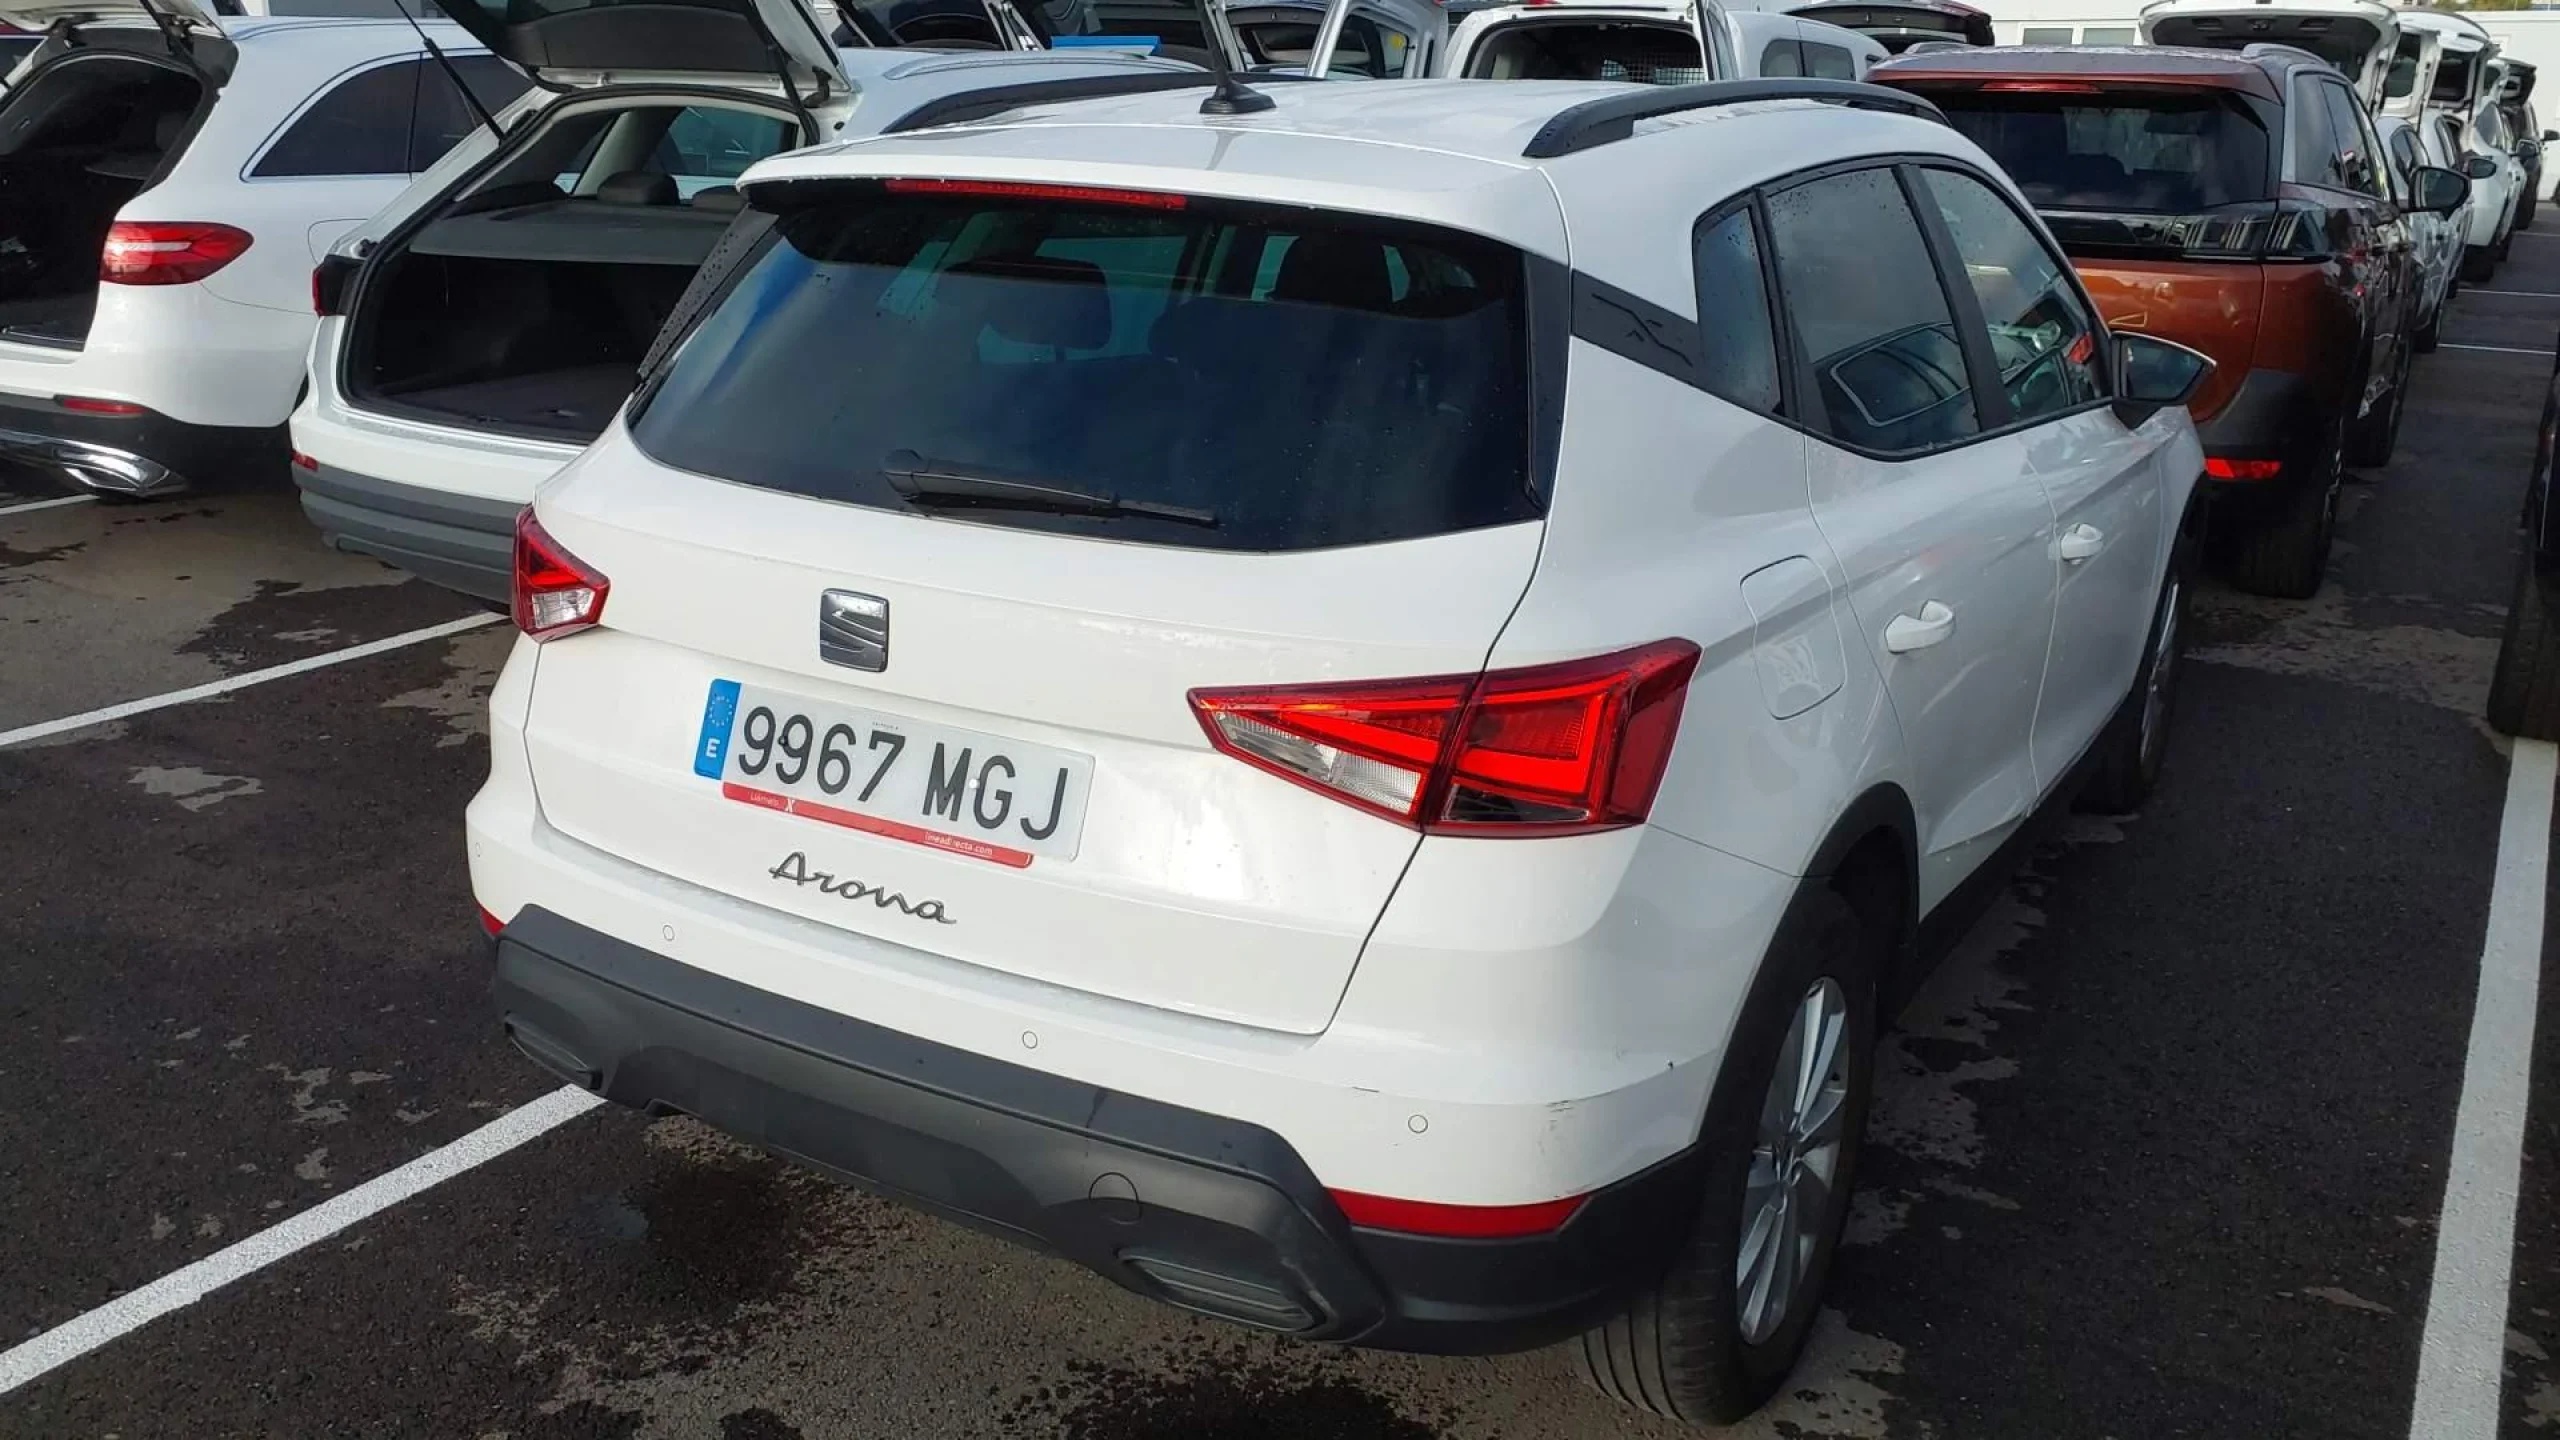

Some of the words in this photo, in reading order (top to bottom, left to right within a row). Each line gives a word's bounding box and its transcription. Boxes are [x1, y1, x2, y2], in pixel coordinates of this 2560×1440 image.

[705, 737, 720, 758] E
[738, 706, 906, 802] 9967
[922, 742, 1069, 841] MGJ
[768, 851, 957, 924] Arona
